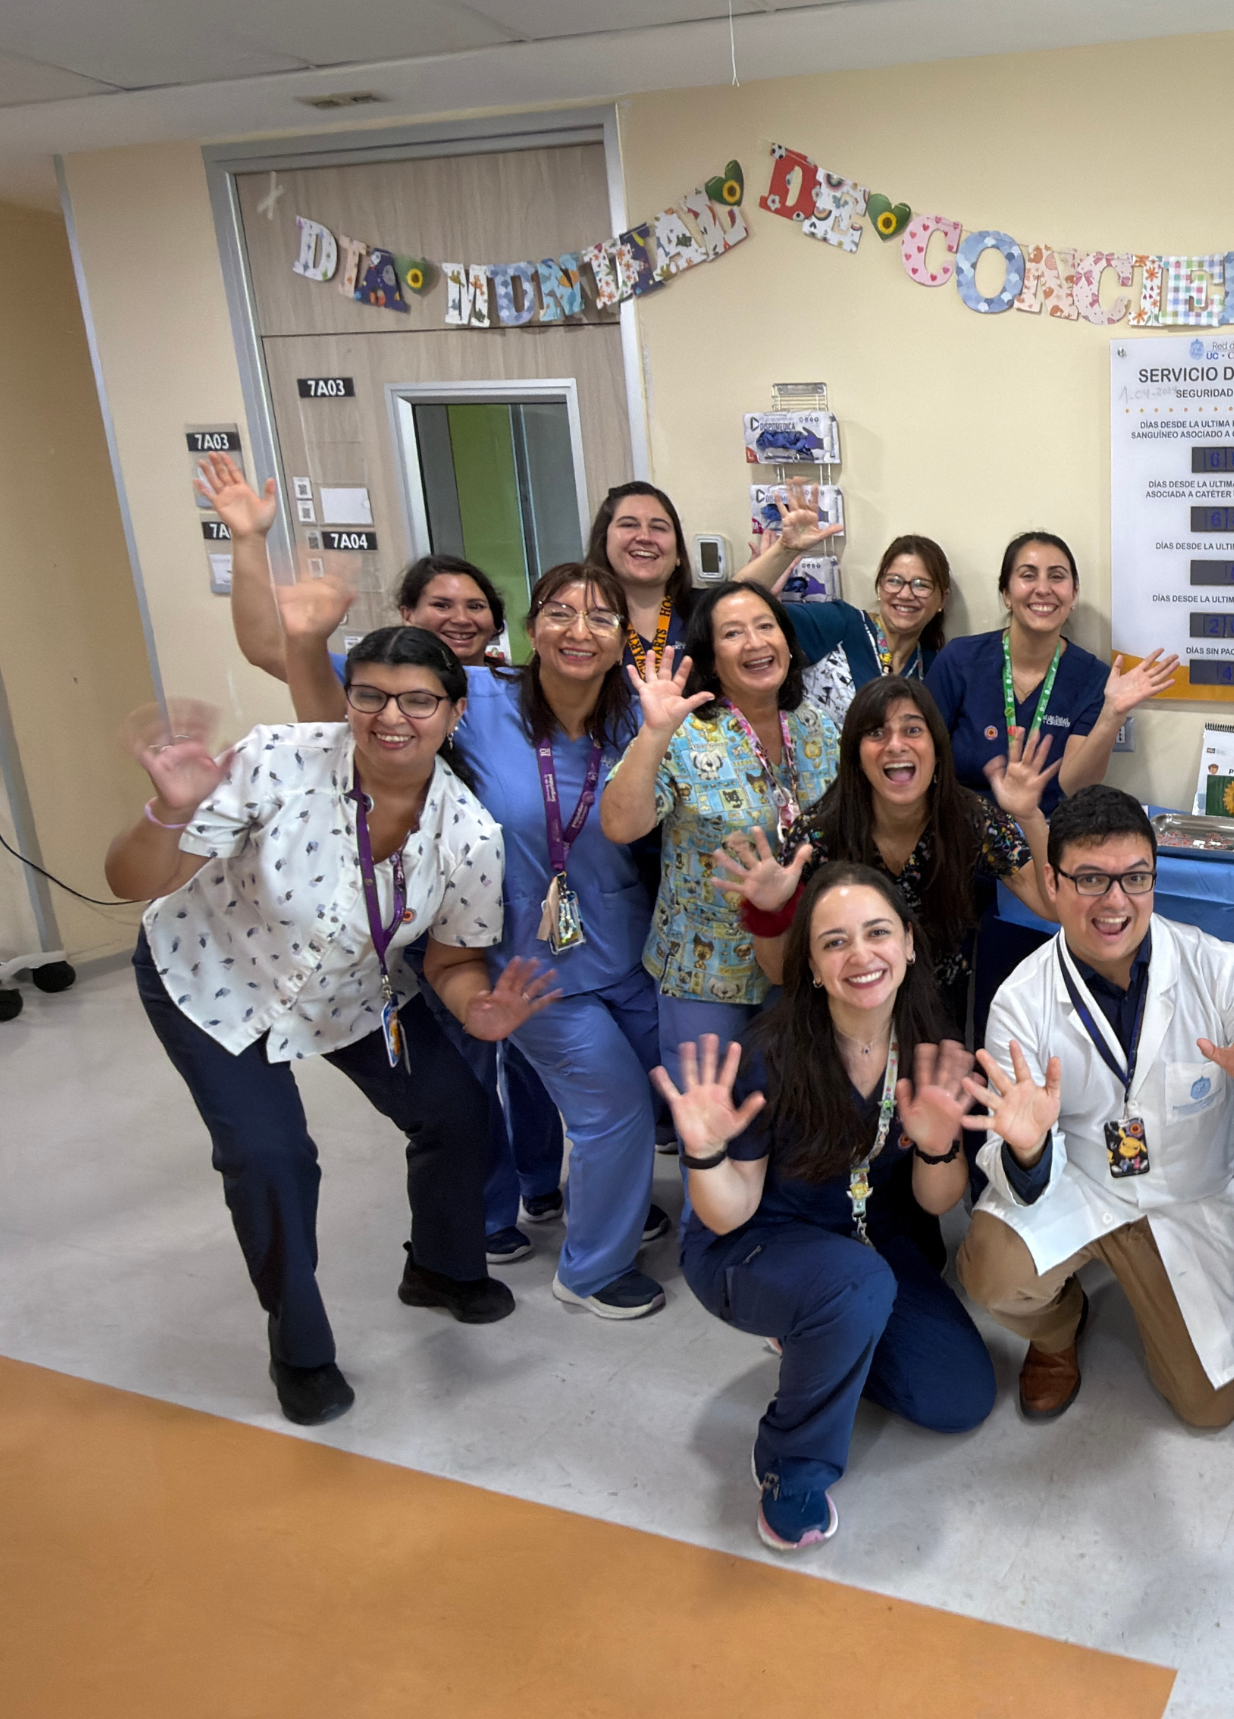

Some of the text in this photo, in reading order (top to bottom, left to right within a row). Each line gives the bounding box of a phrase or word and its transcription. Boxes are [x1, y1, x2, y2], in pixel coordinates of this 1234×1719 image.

[292, 215, 411, 313] DIA
[441, 188, 749, 327] MUNDIAL
[759, 142, 870, 254] DE
[1212, 341, 1228, 350] Red
[1206, 352, 1219, 360] UC
[1138, 366, 1218, 383] SERVICIO
[307, 380, 345, 397] 7A03
[1175, 387, 1234, 399] SEGURIDAD
[1140, 419, 1159, 429] DÍAS
[1160, 420, 1187, 429] DESDE
[1189, 420, 1200, 428] LA
[1201, 420, 1230, 428] ULTIMA
[1131, 430, 1178, 439] SANGUÍNEO
[1180, 430, 1222, 439] ASOCIADO
[1224, 430, 1231, 438] A
[195, 433, 229, 449] 7A03
[1149, 479, 1167, 488] DÍAS
[1168, 480, 1196, 488] DESDE
[1197, 480, 1208, 488] LA
[1146, 490, 1189, 499] ASOCIADA
[1189, 490, 1196, 498] A
[1197, 488, 1232, 498] CATÉTER
[210, 523, 231, 539] 7A
[331, 532, 368, 549] 7A04
[1155, 541, 1174, 550] DÍAS
[1175, 542, 1202, 550] DESDE
[1204, 542, 1215, 550] LA
[1152, 593, 1171, 602] DÍAS
[1172, 594, 1198, 603] DESDE
[1200, 595, 1210, 603] LA
[1186, 646, 1204, 655] DÍAS
[1206, 647, 1219, 656] SIN
